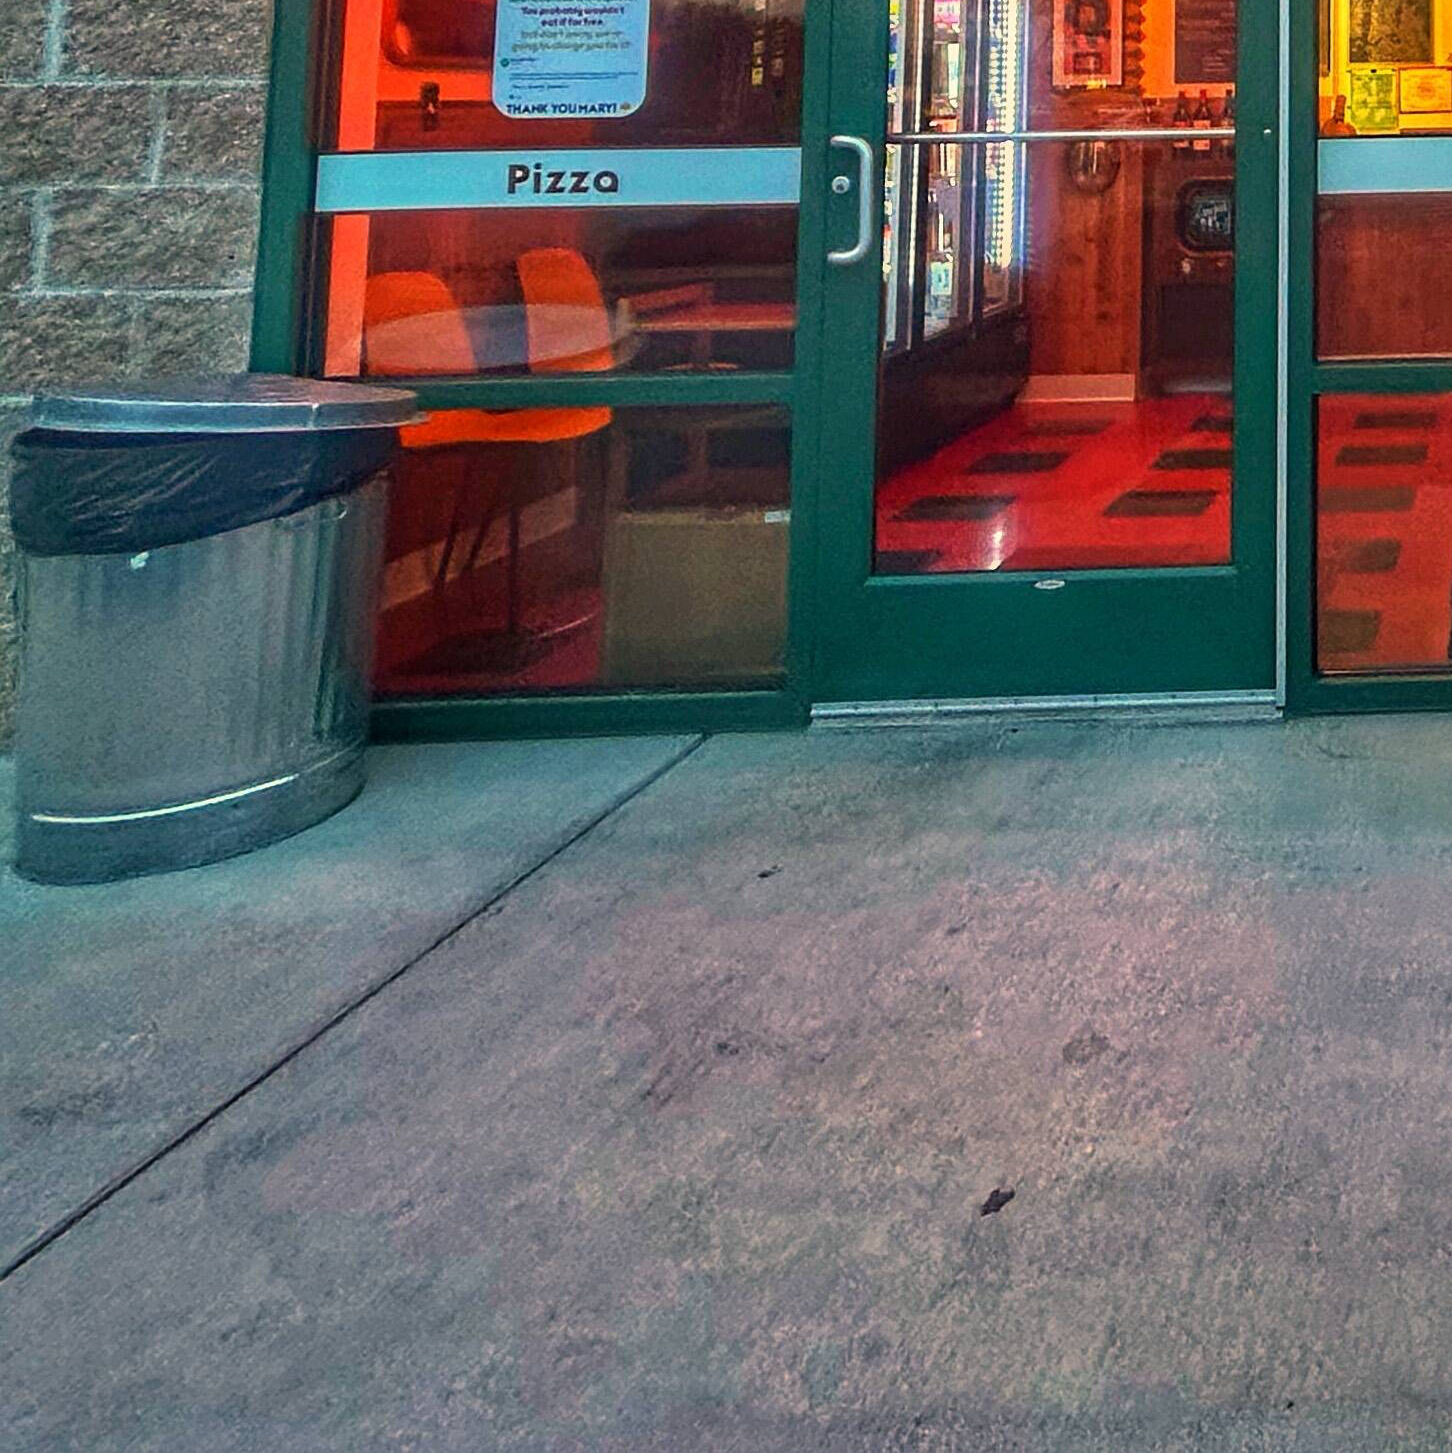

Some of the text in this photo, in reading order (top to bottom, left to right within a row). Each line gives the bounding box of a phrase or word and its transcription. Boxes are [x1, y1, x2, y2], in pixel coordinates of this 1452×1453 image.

[506, 102, 617, 114] THANK YOU MARY!
[507, 162, 619, 194] Pizza
